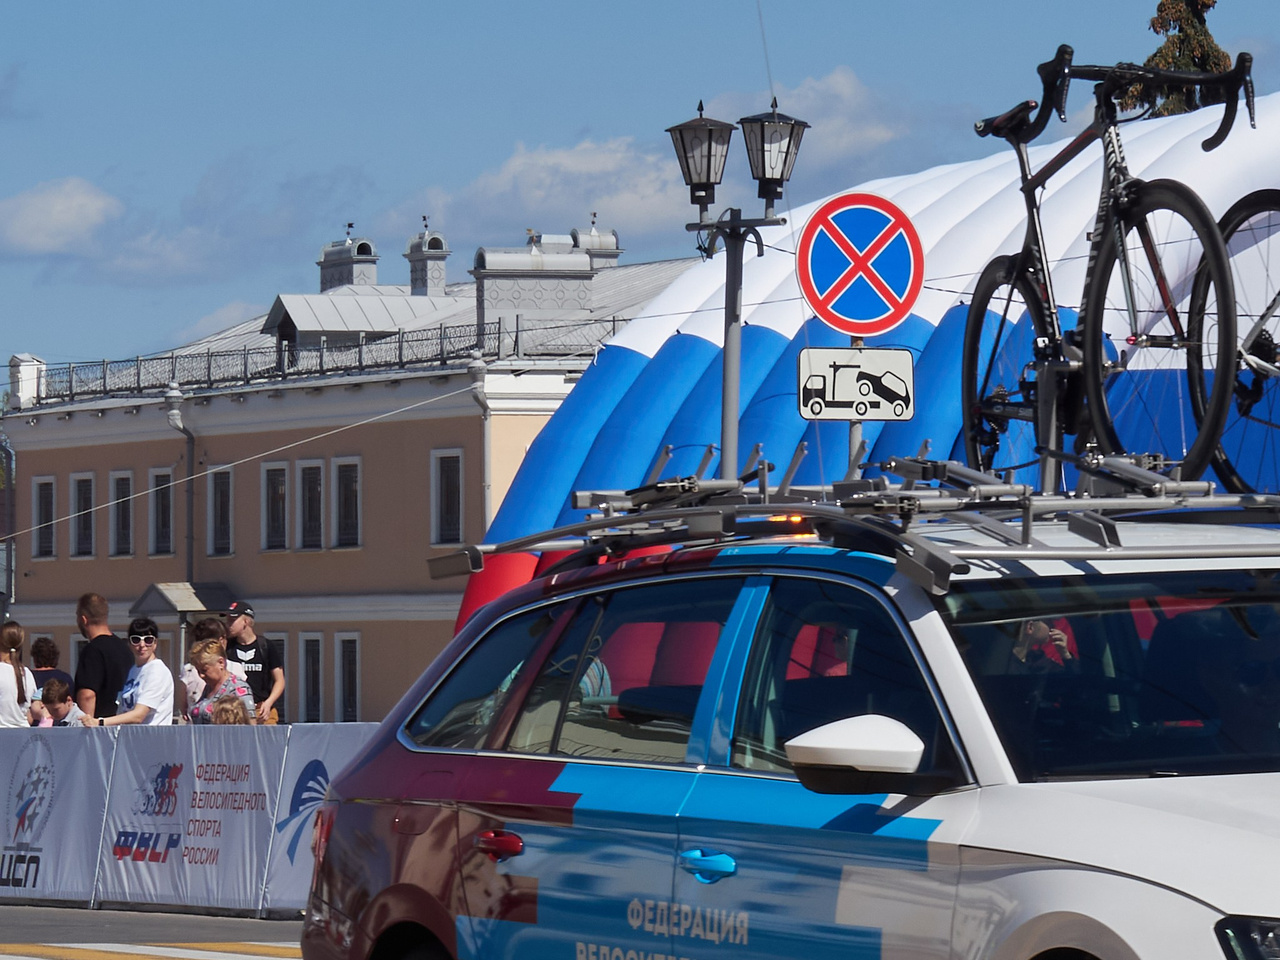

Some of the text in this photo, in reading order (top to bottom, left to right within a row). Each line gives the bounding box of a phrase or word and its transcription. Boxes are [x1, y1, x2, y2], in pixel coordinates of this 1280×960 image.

[195, 764, 250, 783] ФЕДЕРАЦИЯ
[190, 791, 267, 812] ВЕЛОСИПЕДНОГО
[187, 819, 222, 838] СПОРТА
[182, 846, 219, 866] РОССИИ
[627, 898, 749, 945] ФЕДЕРАЦИЯ
